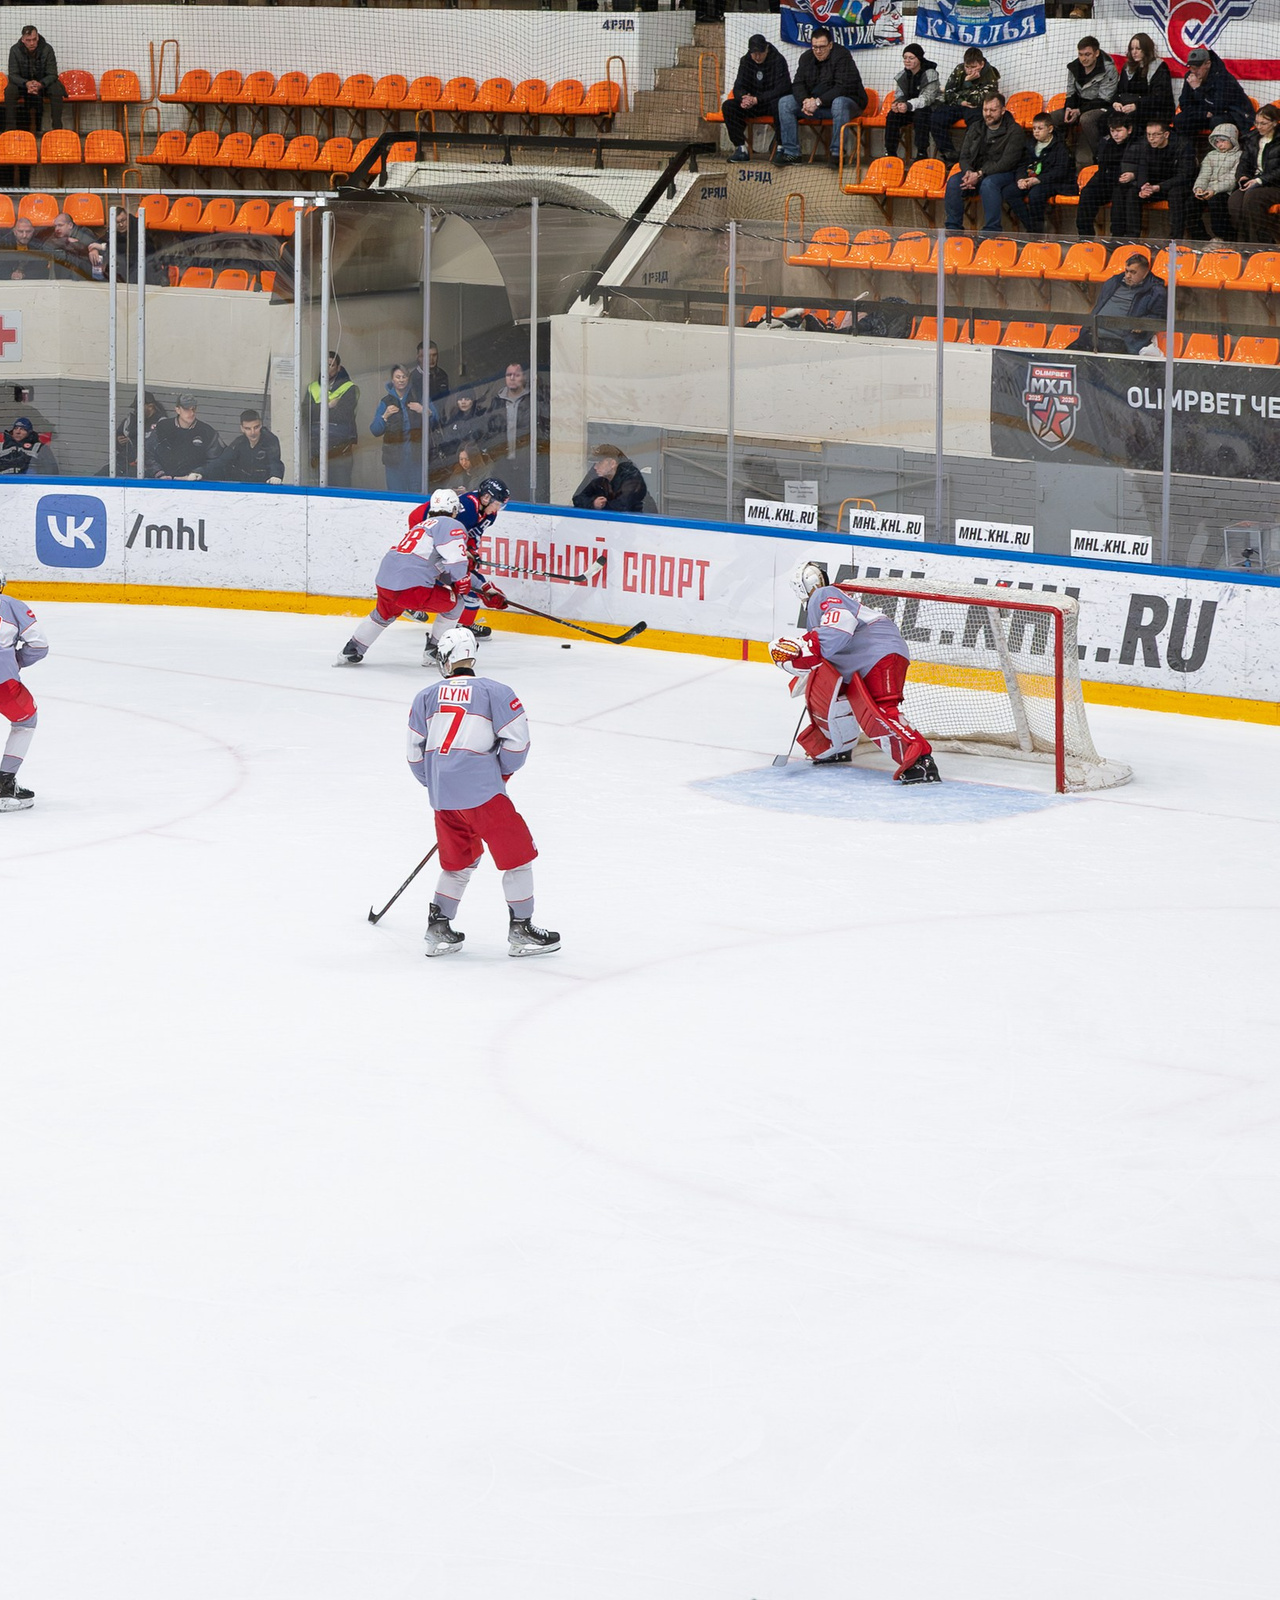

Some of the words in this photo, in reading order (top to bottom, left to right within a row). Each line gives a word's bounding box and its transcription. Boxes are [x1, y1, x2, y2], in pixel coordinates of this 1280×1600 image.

[925, 15, 1038, 45] КРЫЛЬЯ
[1034, 369, 1069, 378] OLIMPBET
[1031, 378, 1072, 394] МХЛ
[1127, 386, 1246, 416] OLIMPBET
[747, 505, 815, 525] MHL.KHL.RU
[852, 515, 922, 535] MHL.KHL.RU
[959, 525, 1031, 546] MHL.KHL.RU
[1074, 536, 1149, 557] MHL.KHL.RU
[478, 535, 609, 589] БОЛЬШОЙ
[622, 551, 710, 601] СПОРТ
[823, 611, 841, 625] 30
[439, 687, 470, 702] ILYIN
[439, 705, 466, 754] 7
